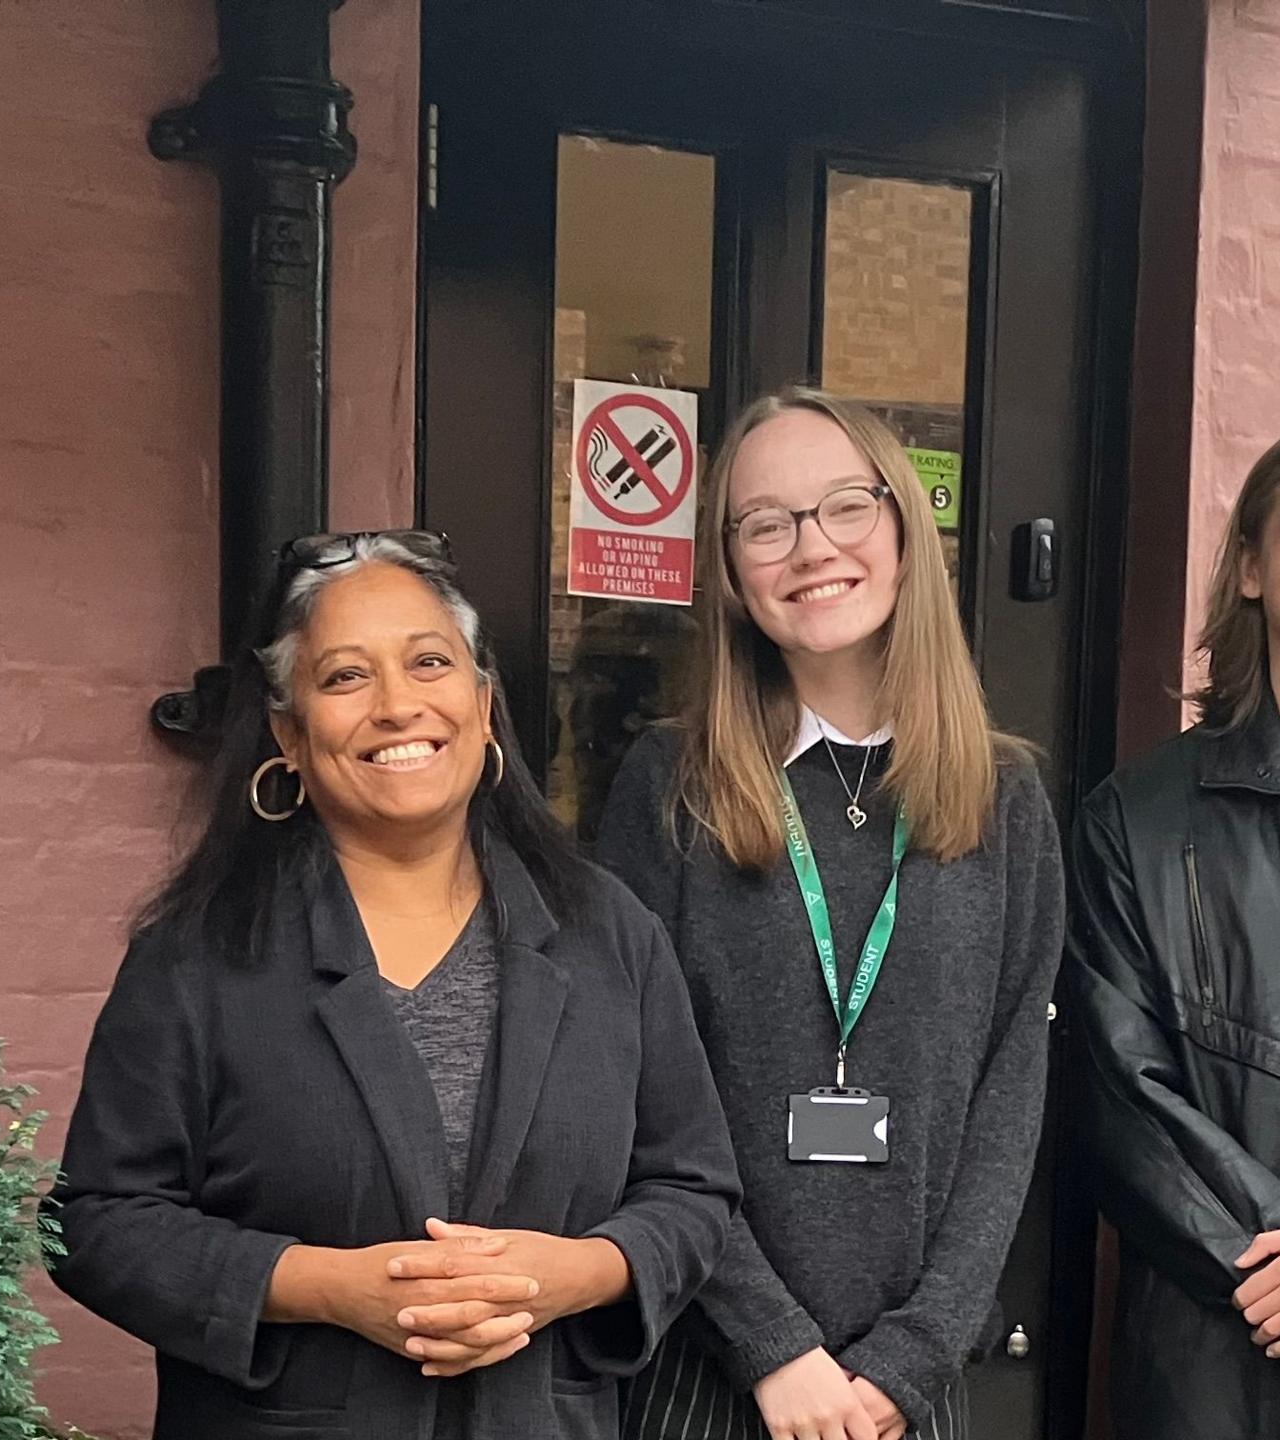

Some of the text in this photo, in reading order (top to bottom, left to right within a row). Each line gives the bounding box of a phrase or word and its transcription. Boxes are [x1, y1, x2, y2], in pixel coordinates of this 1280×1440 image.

[916, 454, 954, 470] RATING
[934, 487, 947, 508] 5
[597, 535, 665, 554] NO SMOKING
[602, 550, 659, 567] OR VAPING
[578, 562, 682, 584] ALLOWED ON THESE
[602, 578, 656, 595] PREMISES
[820, 938, 839, 1005] STUDENT
[848, 943, 880, 1010] STUDENT
